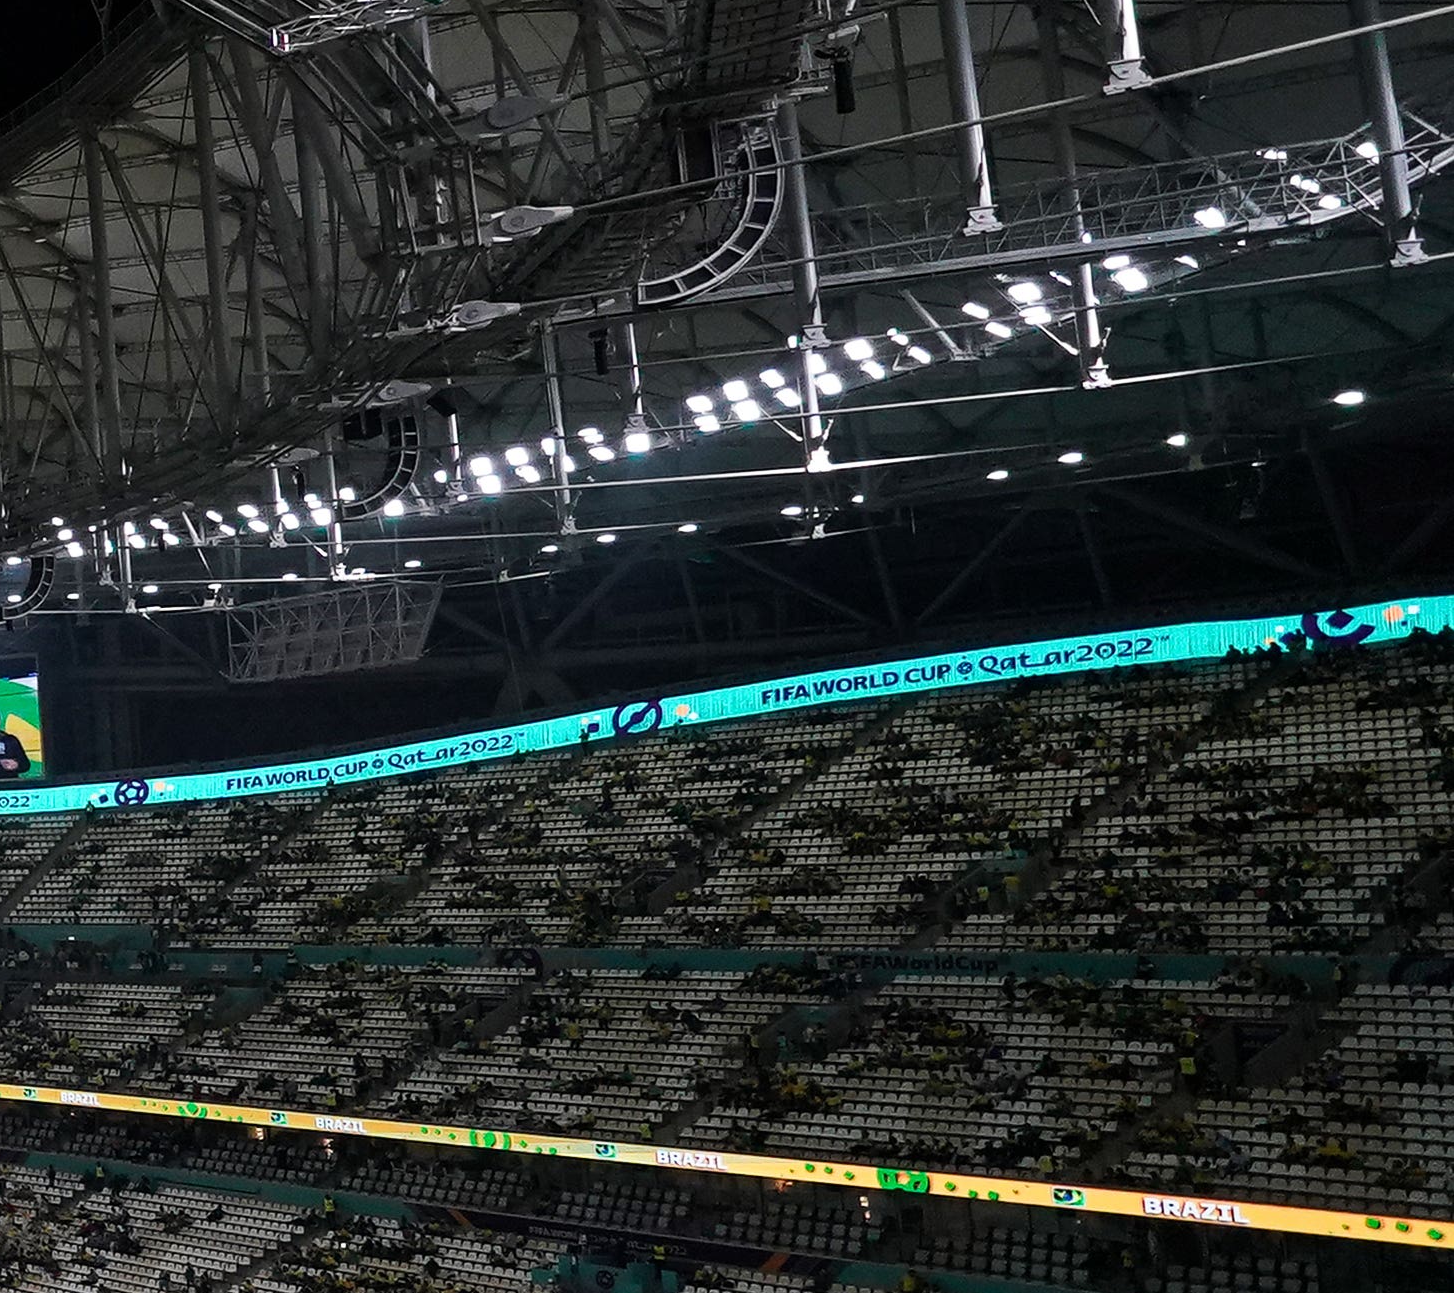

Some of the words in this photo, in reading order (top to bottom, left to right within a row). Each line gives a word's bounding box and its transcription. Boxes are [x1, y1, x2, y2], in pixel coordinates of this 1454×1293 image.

[761, 684, 810, 707] FIFA
[815, 671, 899, 696] WORLD
[903, 661, 951, 685] CUP
[226, 773, 263, 791] FIFA
[266, 767, 330, 787] WORLD
[334, 760, 369, 778] CUP
[315, 1118, 367, 1135] BRAZIL
[656, 1149, 727, 1171] BRAZIL
[1143, 1197, 1250, 1224] BRAZIL
